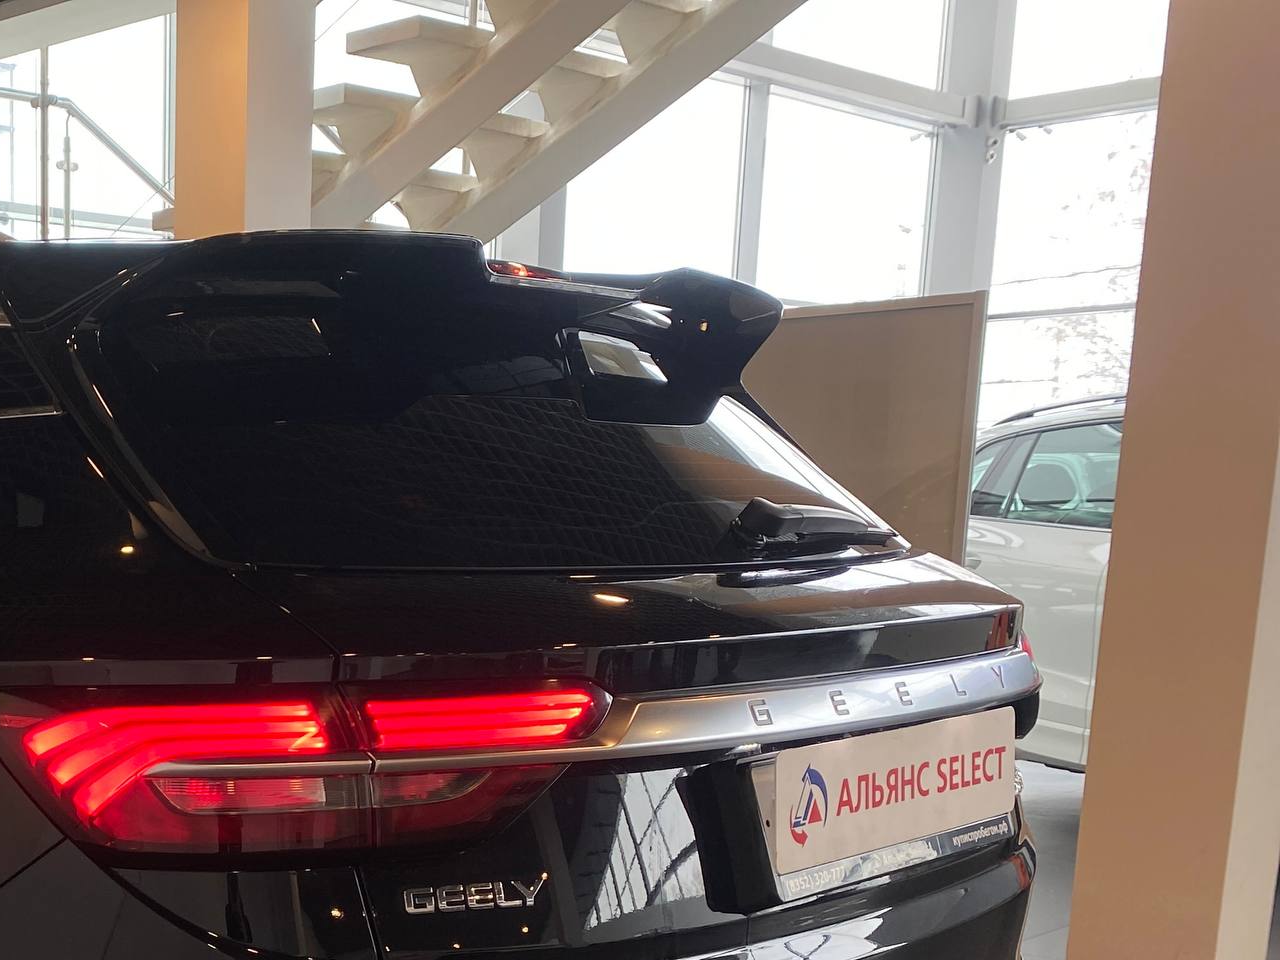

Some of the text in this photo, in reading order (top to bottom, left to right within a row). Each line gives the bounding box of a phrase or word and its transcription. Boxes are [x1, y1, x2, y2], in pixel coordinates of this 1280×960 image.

[747, 665, 1006, 727] GEELY
[835, 746, 1007, 817] АЛЬЯНС SELECT
[403, 875, 547, 915] GEELY
